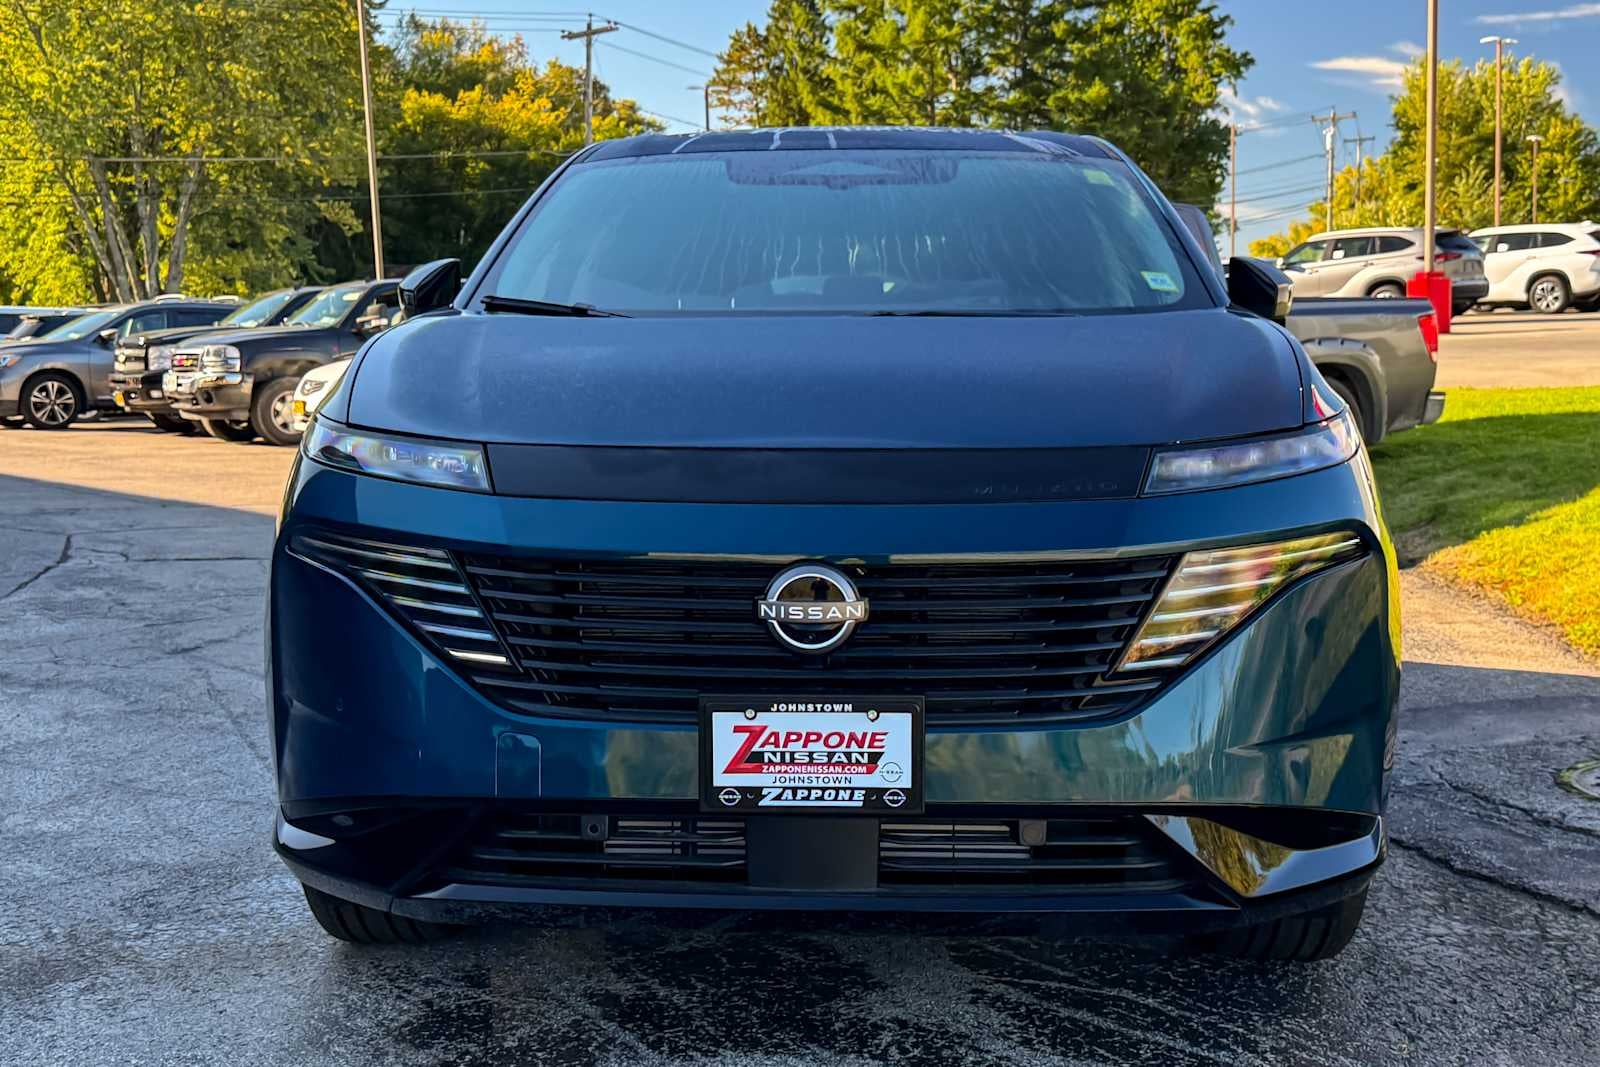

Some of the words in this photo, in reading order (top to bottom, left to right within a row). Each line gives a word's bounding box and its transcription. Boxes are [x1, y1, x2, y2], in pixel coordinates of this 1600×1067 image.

[760, 604, 861, 619] NISSAN
[771, 703, 853, 712] JOHNSTOWN
[722, 725, 889, 774] ZAPPONE
[763, 752, 869, 764] NISSAN
[762, 765, 867, 774] ZAPPONENISSAN.COM
[772, 776, 852, 784] JOHNSTOWN
[758, 788, 866, 807] ZAPPONE
